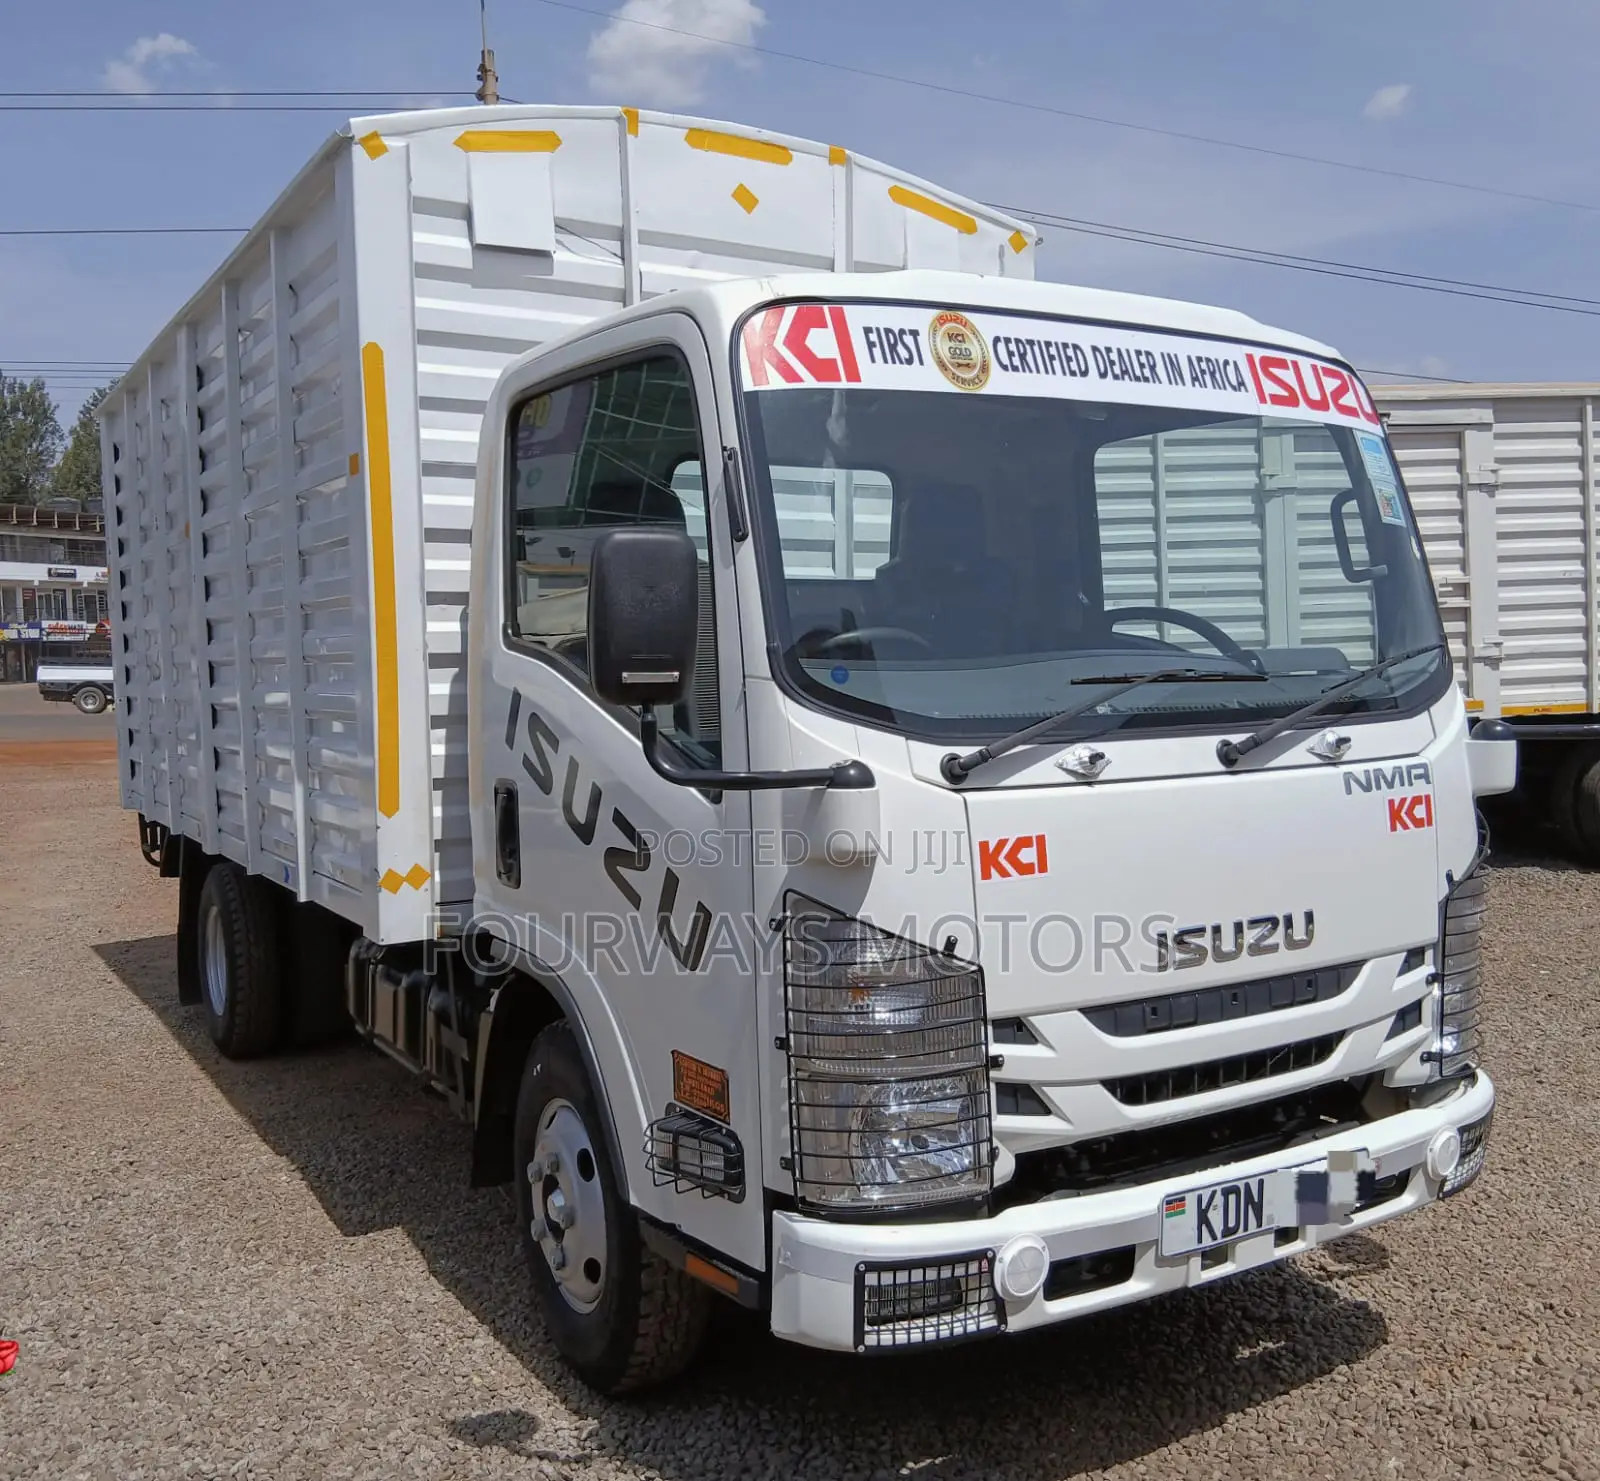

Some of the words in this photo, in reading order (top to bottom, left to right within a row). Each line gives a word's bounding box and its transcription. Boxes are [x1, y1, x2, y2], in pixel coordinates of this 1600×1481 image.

[743, 306, 861, 387] KCI
[863, 326, 924, 366] FIRST
[936, 312, 968, 328] ISUZU
[947, 332, 966, 344] KCI
[948, 346, 973, 357] GOLD
[992, 335, 1090, 378] CERTIFIED
[1090, 345, 1163, 385] DEALER
[1160, 351, 1187, 387] IN
[1187, 354, 1249, 393] AFRICA
[1245, 353, 1379, 426] ISUZU
[504, 686, 713, 972] ISUZU
[1387, 794, 1434, 832] KCI
[978, 834, 1049, 881] KCI
[1157, 909, 1315, 973] ISUZU
[1197, 1178, 1265, 1244] KDN
